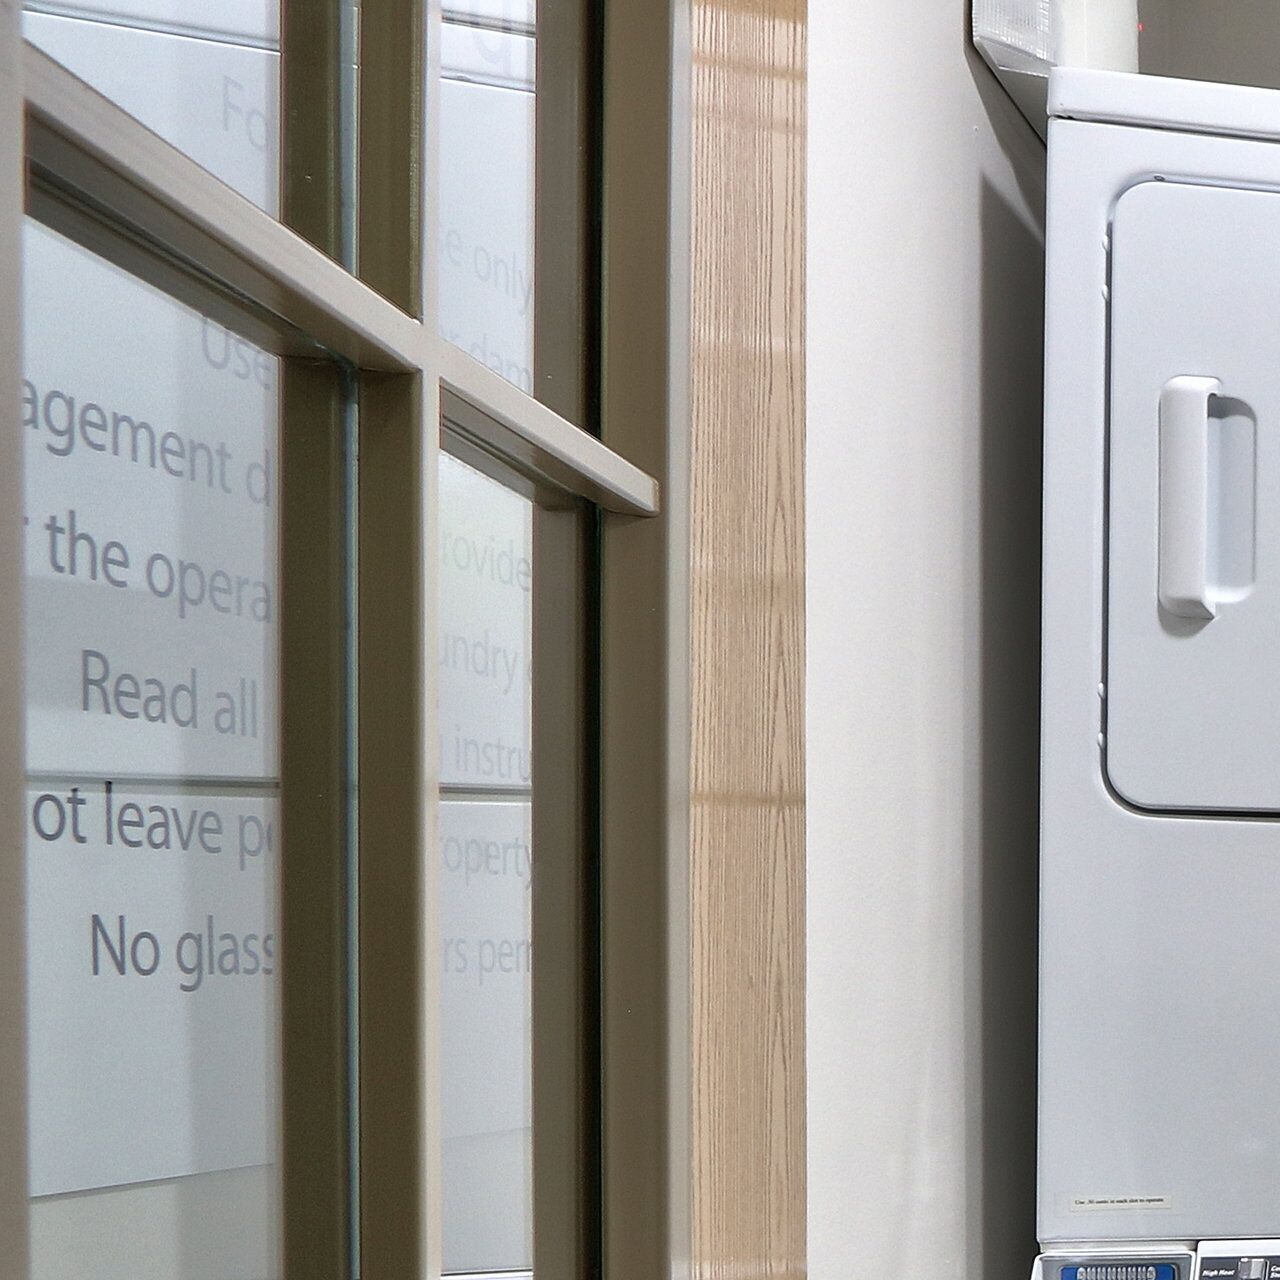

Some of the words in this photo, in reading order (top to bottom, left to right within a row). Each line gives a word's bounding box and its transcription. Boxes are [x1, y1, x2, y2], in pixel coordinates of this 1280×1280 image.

[44, 509, 130, 588] the
[81, 649, 198, 729] Read
[214, 677, 258, 739] all
[104, 780, 224, 855] leave
[91, 914, 161, 977] No
